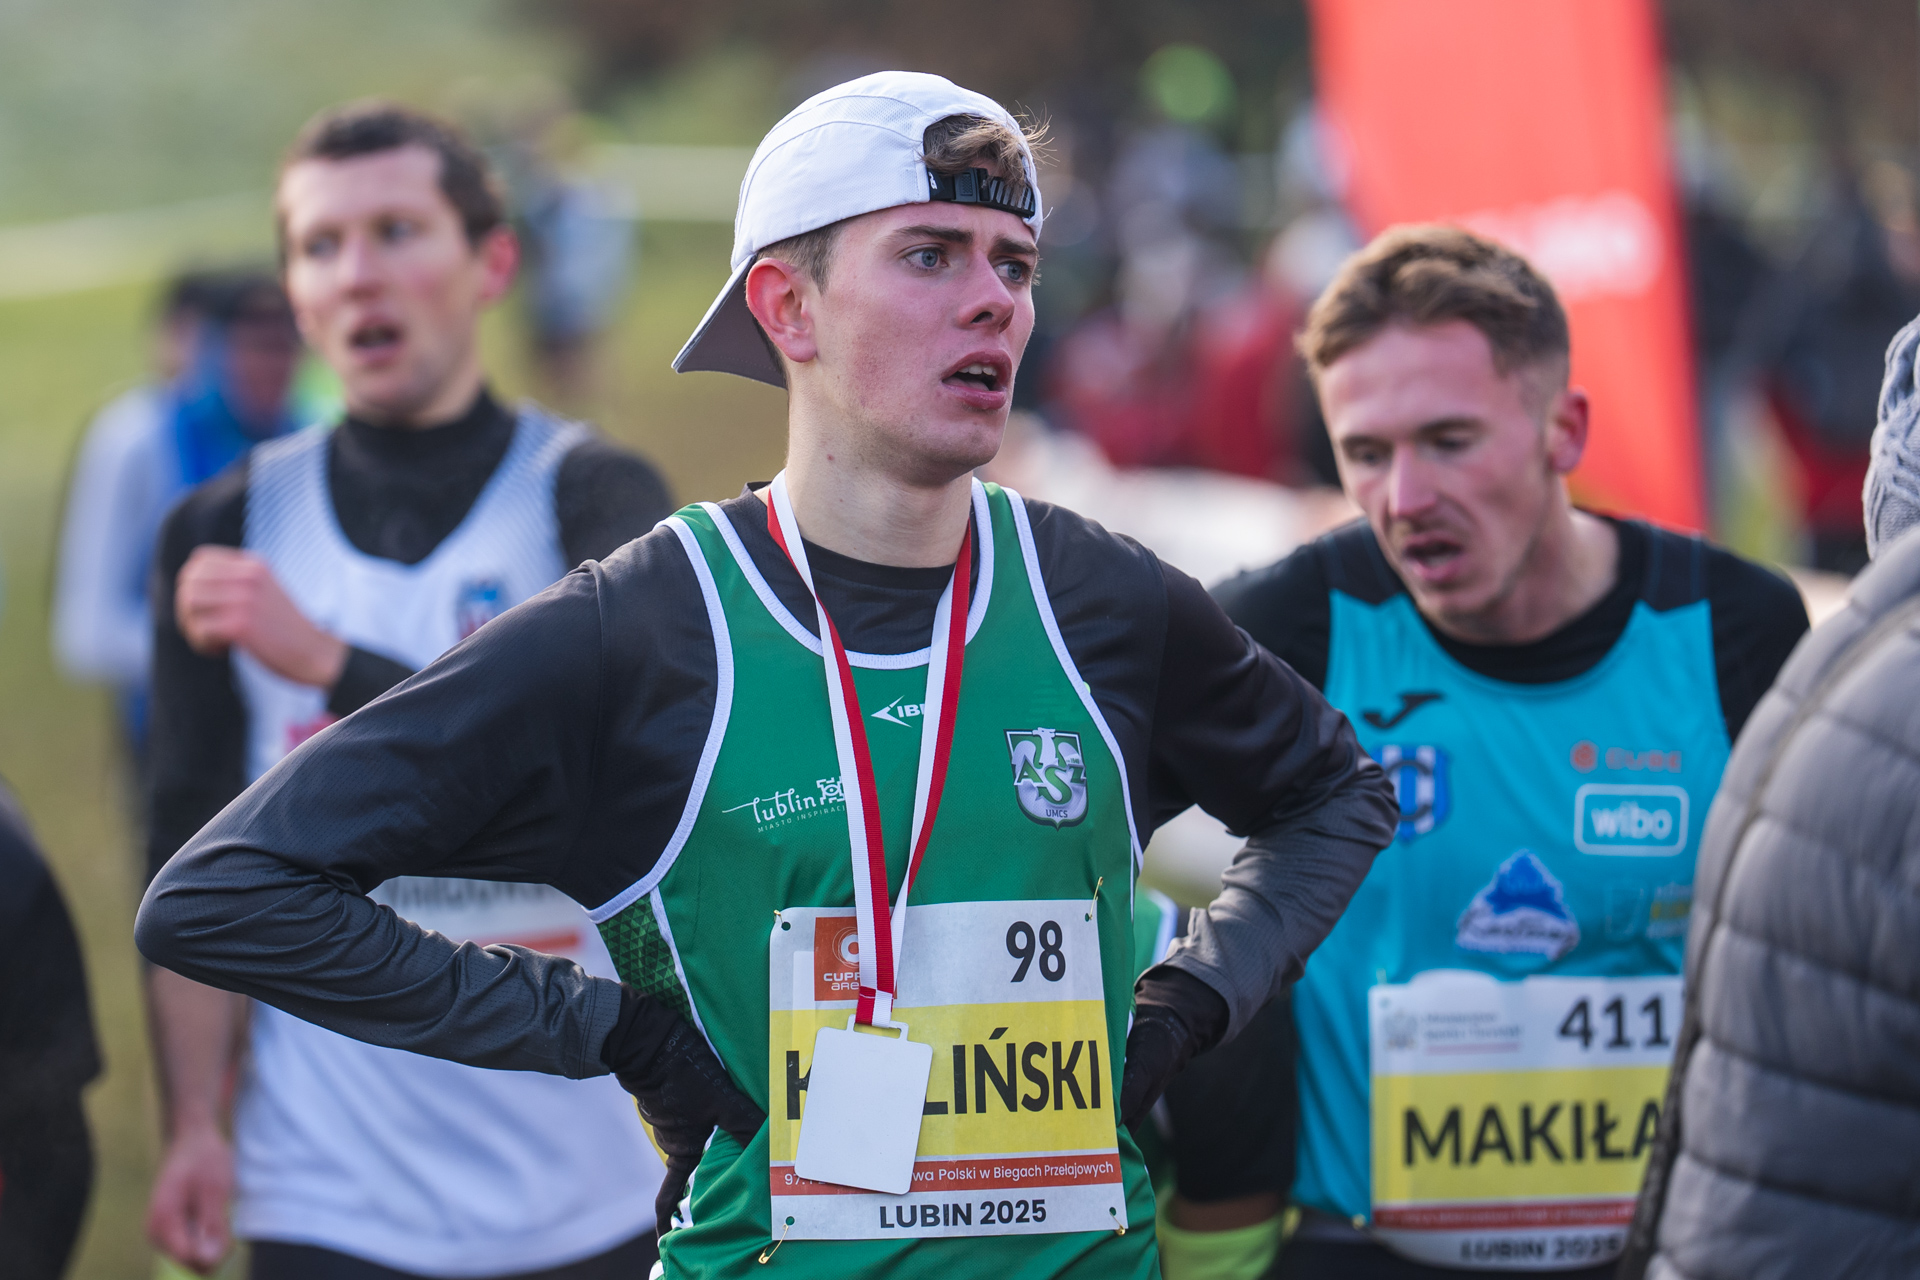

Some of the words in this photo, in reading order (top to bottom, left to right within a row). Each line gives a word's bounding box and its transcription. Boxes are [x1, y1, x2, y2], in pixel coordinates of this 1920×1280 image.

[757, 817, 792, 833] MIASTO
[797, 804, 846, 820] INSPIRACJ
[1045, 808, 1068, 819] UMCS
[1591, 800, 1672, 839] wibo
[1005, 920, 1066, 983] 98
[1556, 993, 1671, 1050] 411
[938, 1167, 976, 1181] Polski
[979, 1169, 991, 1180] w
[993, 1164, 1042, 1182] Biegach
[1044, 1161, 1114, 1179] Przełajowych
[879, 1203, 972, 1229] LUBIN
[980, 1199, 1047, 1225] 2025
